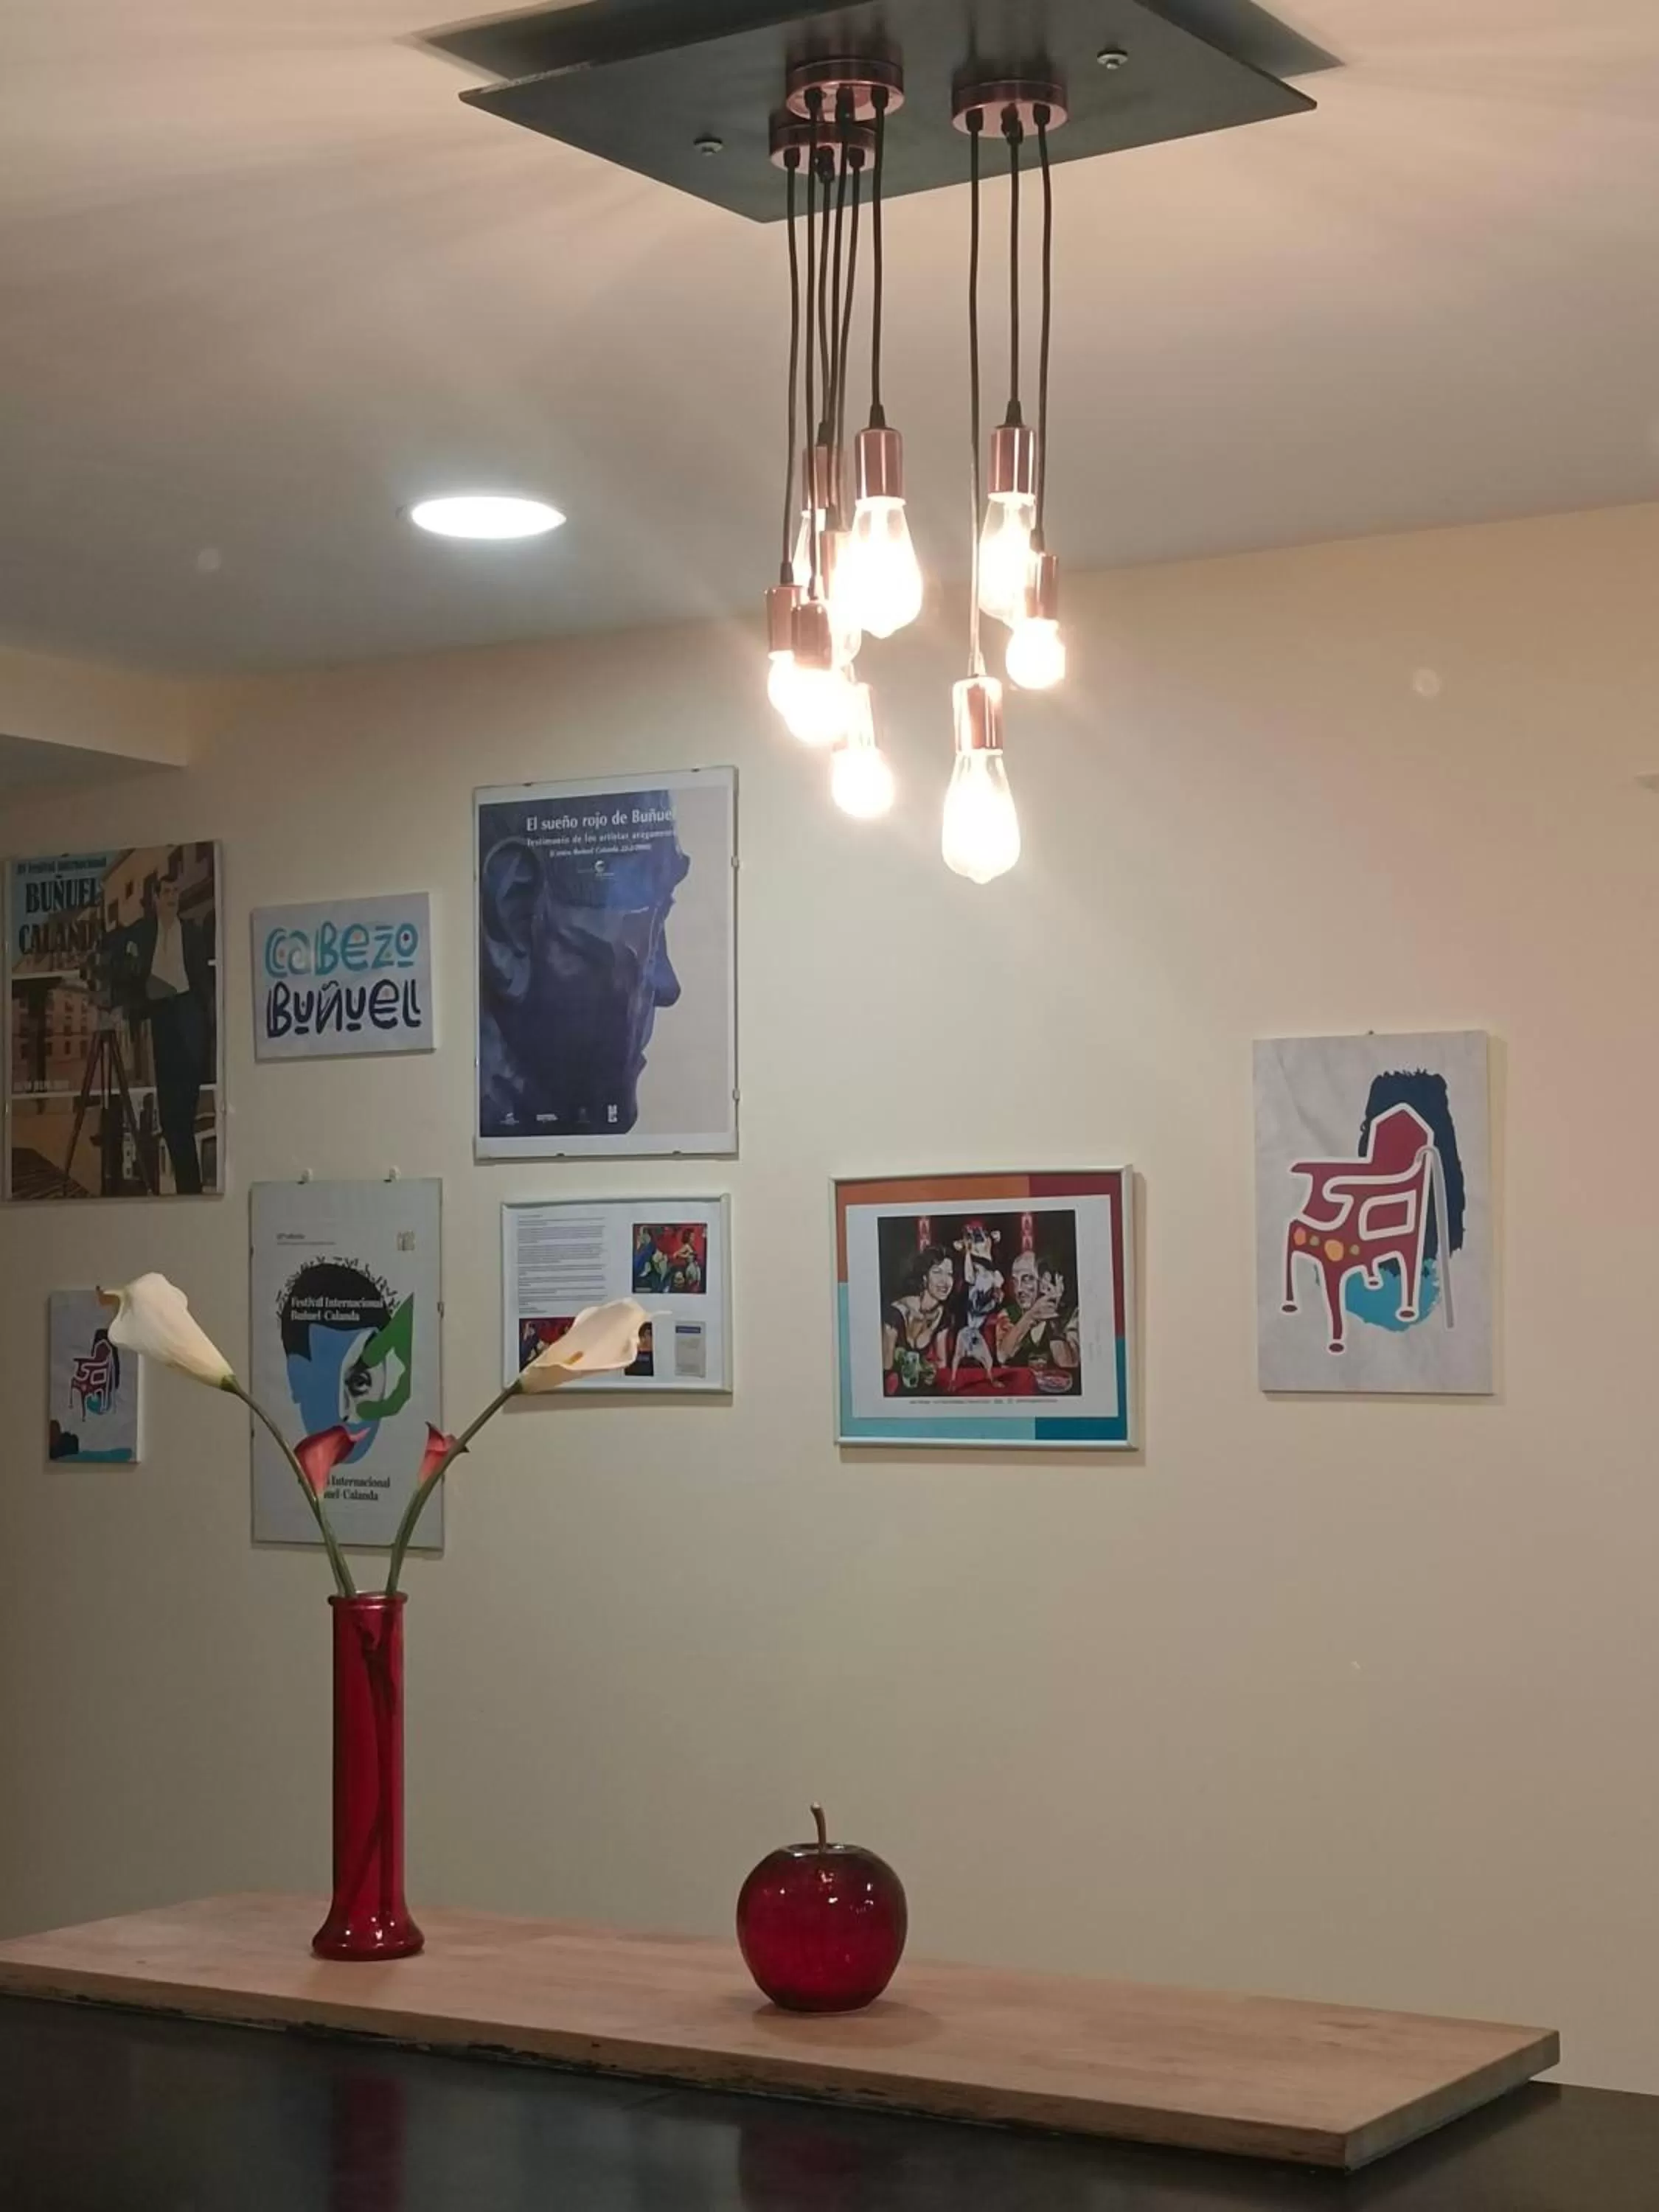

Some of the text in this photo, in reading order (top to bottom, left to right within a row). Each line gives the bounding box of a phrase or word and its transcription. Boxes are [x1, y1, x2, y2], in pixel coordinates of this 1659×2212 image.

[526, 815, 538, 832] El
[541, 814, 578, 831] sueño
[582, 812, 608, 830] rojo
[611, 810, 627, 825] de
